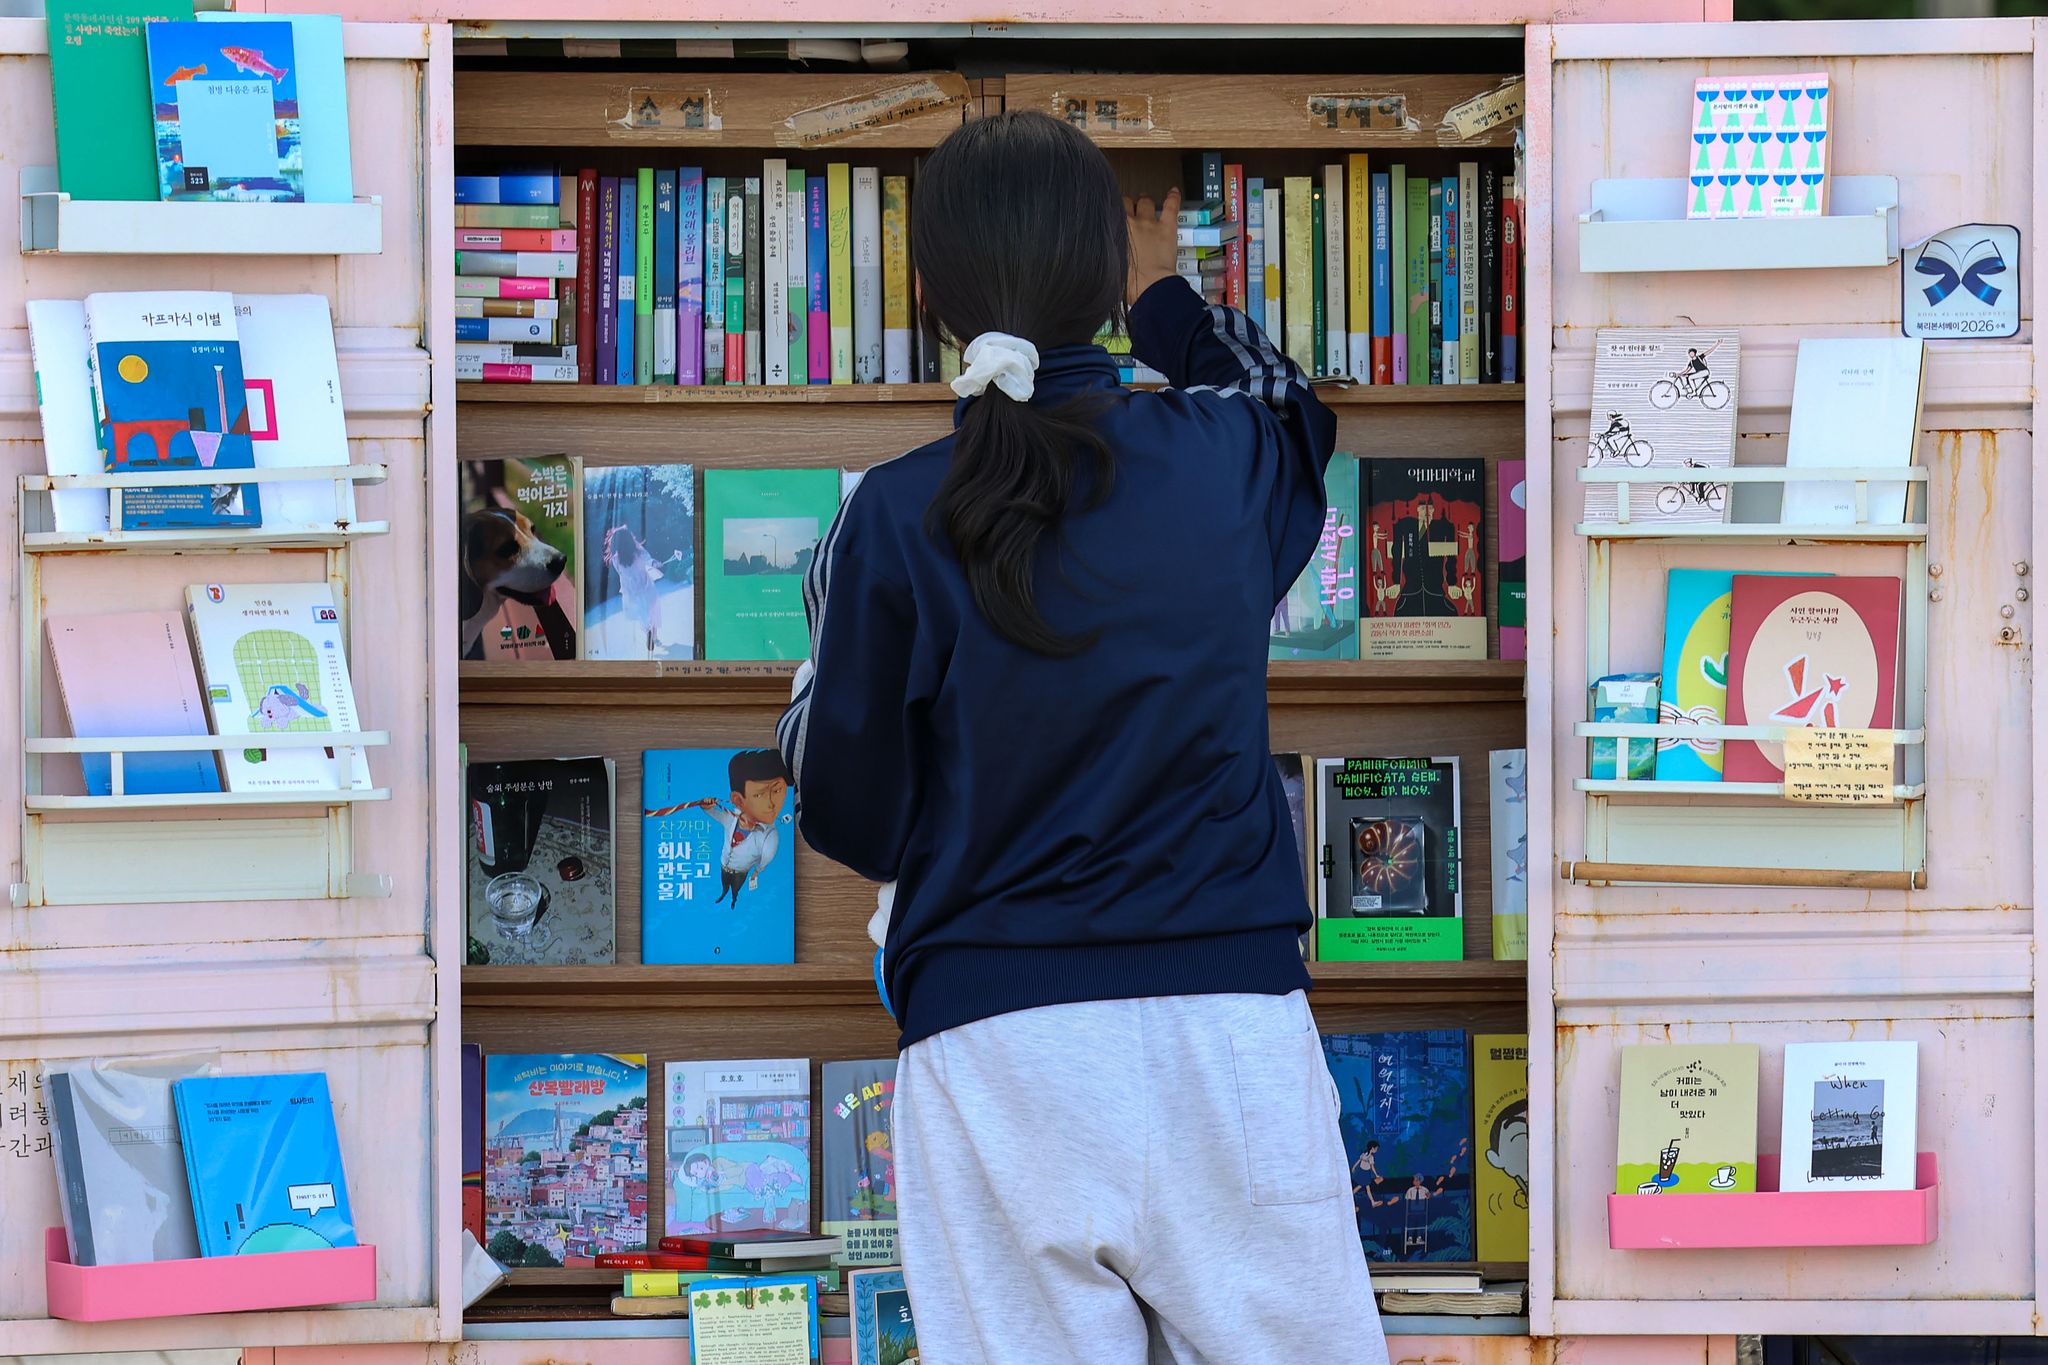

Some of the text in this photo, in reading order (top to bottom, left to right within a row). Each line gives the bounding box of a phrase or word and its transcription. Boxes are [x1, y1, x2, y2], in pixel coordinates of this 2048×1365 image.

[141, 311, 222, 327] 카프카식 이별
[1961, 319, 1994, 333] 2026
[530, 465, 567, 484] 수박은
[517, 483, 568, 504] 먹어보고
[543, 501, 568, 518] 가지
[1790, 607, 1806, 615] 시인
[1336, 772, 1440, 784] PANIFICATA GEN.
[486, 779, 553, 793] 술의 주성분은 낭만
[659, 821, 712, 840] 잠깐만
[657, 842, 711, 860] 회사 좀
[658, 862, 711, 881] 관두고
[658, 882, 693, 901] 올게
[513, 1066, 548, 1083] 세탁비는
[549, 1062, 584, 1072] 이야기로
[1676, 1077, 1702, 1086] 커피는
[1831, 1075, 1868, 1090] When
[1660, 1088, 1717, 1097] 남이 내려준 게
[1671, 1101, 1679, 1109] 더
[1679, 1110, 1706, 1119] 맛있다
[1811, 1105, 1886, 1124] Letting Go
[862, 1228, 877, 1237] 나게
[870, 1240, 885, 1249] 없이
[848, 1251, 862, 1261] 성인
